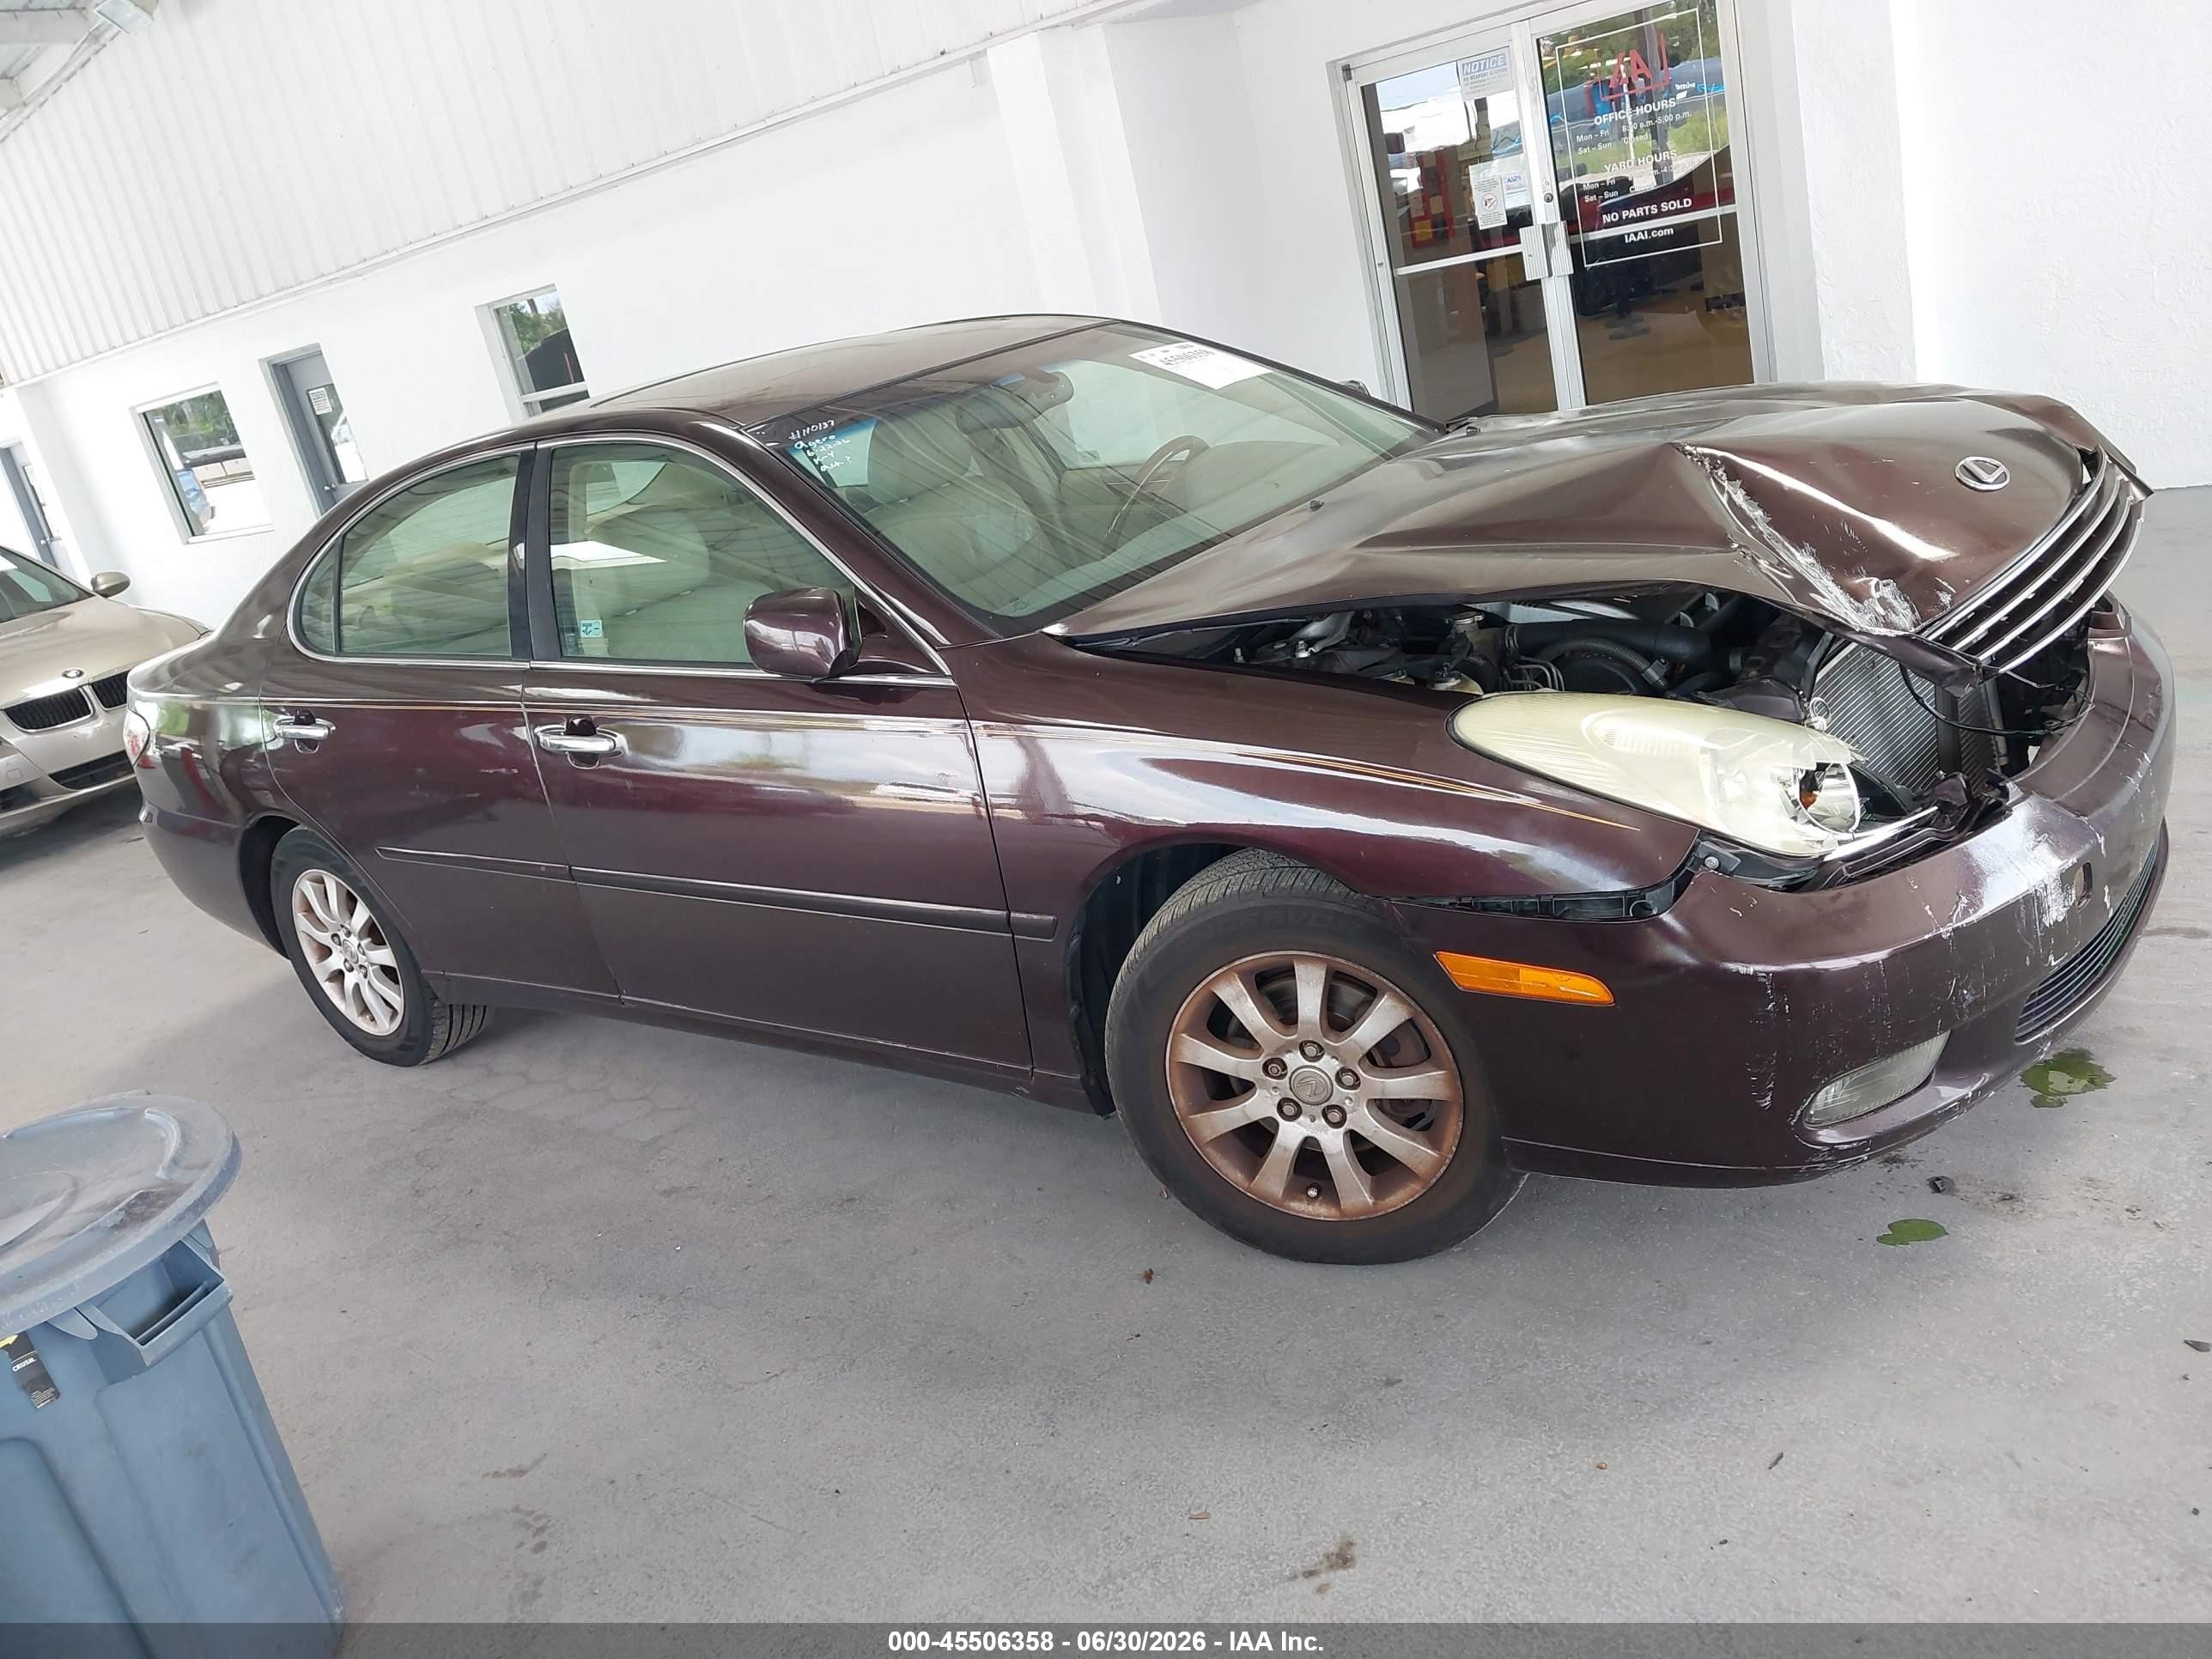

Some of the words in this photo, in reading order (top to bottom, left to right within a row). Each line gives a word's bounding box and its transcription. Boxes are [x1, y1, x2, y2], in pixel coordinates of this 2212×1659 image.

[1463, 55, 1505, 76] NOTICE
[1594, 109, 1633, 125] OFFICE
[1636, 98, 1676, 116] HOURS
[1577, 133, 1592, 143] Mon
[1601, 129, 1609, 137] Fri
[1622, 122, 1638, 132] 8:0
[1675, 111, 1692, 121] p.m.
[1578, 146, 1590, 155] Sat
[1598, 142, 1612, 151] Sun
[1623, 133, 1648, 144] Cosed
[1604, 160, 1634, 173] YARD
[1638, 150, 1677, 166] HOURS
[1583, 182, 1599, 191] Mon
[1607, 178, 1616, 186] Fri
[1584, 194, 1597, 203] Sat
[1604, 190, 1618, 199] Sun
[1602, 212, 1619, 224] NO
[1622, 205, 1658, 219] PARTS
[1661, 198, 1692, 212] SOLD
[1624, 228, 1674, 243] IAAI.com
[789, 419, 835, 441] #110137
